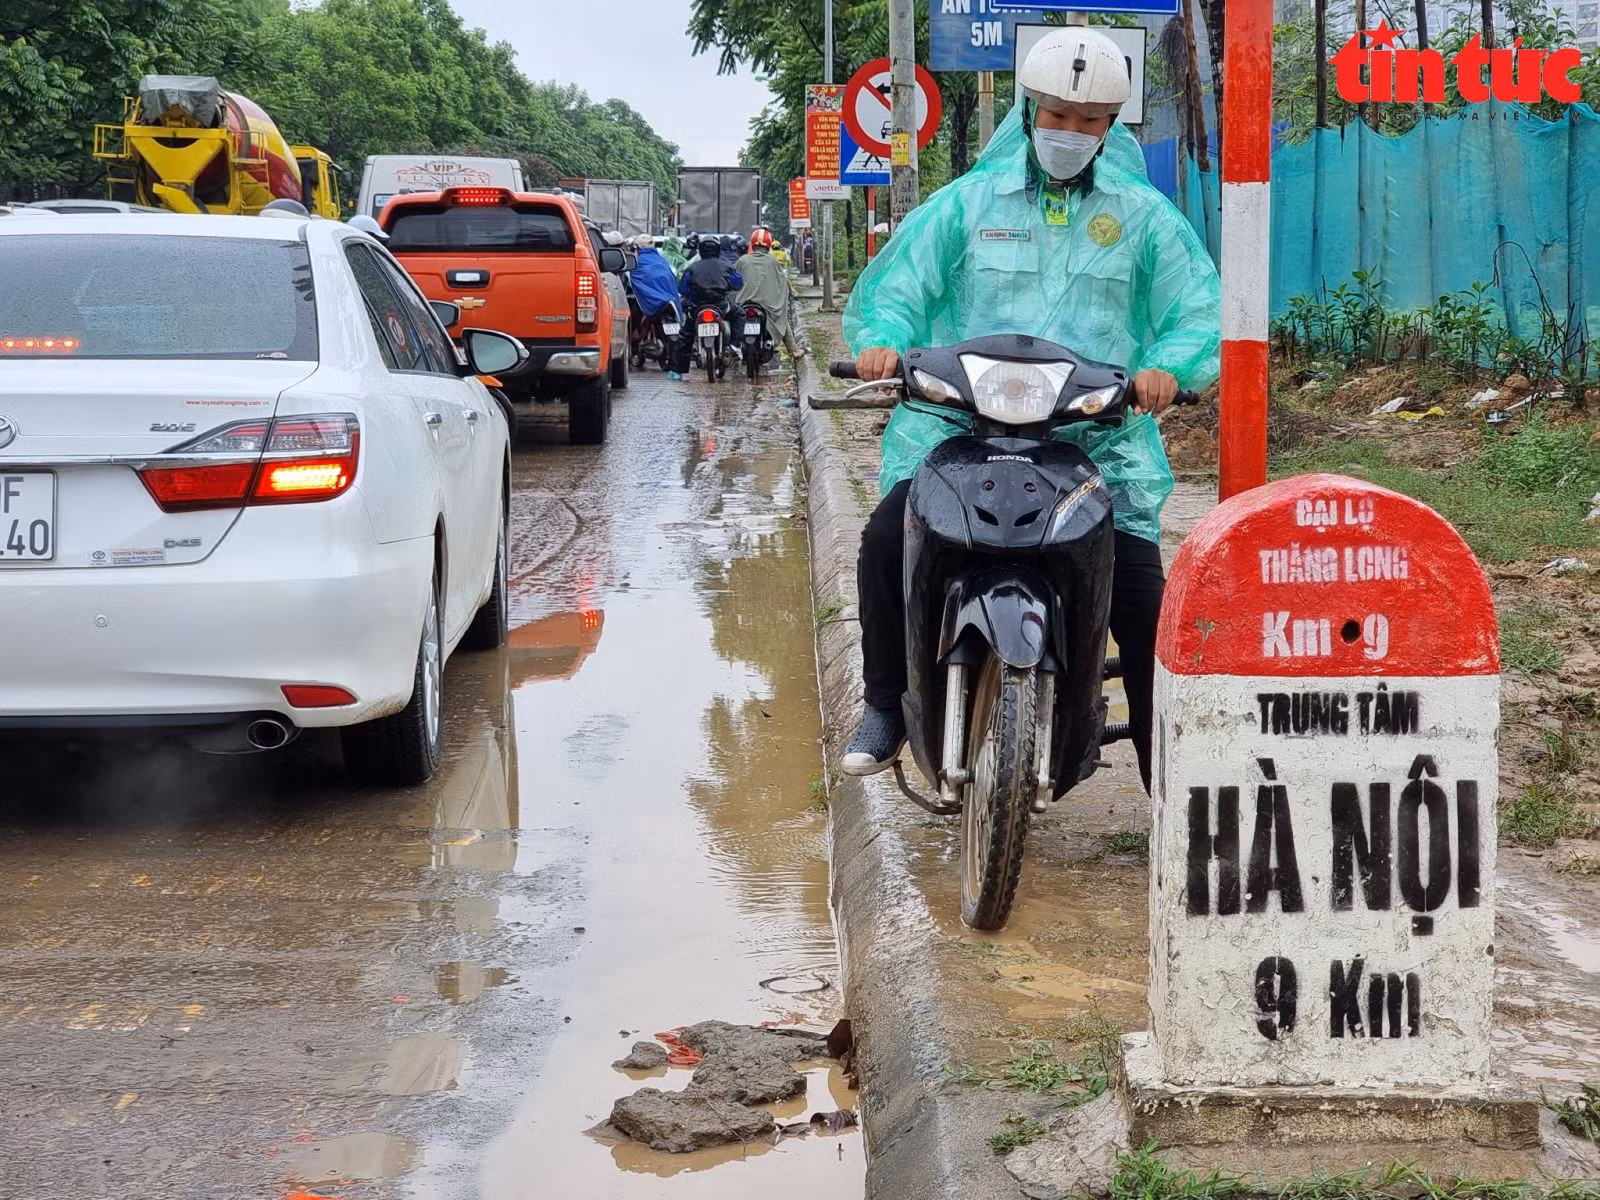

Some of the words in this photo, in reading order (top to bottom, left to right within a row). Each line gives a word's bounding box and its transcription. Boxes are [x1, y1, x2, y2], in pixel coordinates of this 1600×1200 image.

[971, 21, 1003, 47] 5M
[433, 164, 454, 172] VIP
[986, 455, 1034, 463] HONDA
[0, 475, 24, 514] F
[1344, 546, 1409, 581] LONG
[1263, 611, 1332, 658] Km
[1363, 612, 1390, 660] 9
[1257, 692, 1349, 736] TRUNG
[1355, 682, 1420, 735] TÂM
[1186, 757, 1305, 916] HÀ
[1331, 754, 1480, 936] NỘI
[1254, 956, 1298, 1041] 9
[1330, 958, 1421, 1039] Km
